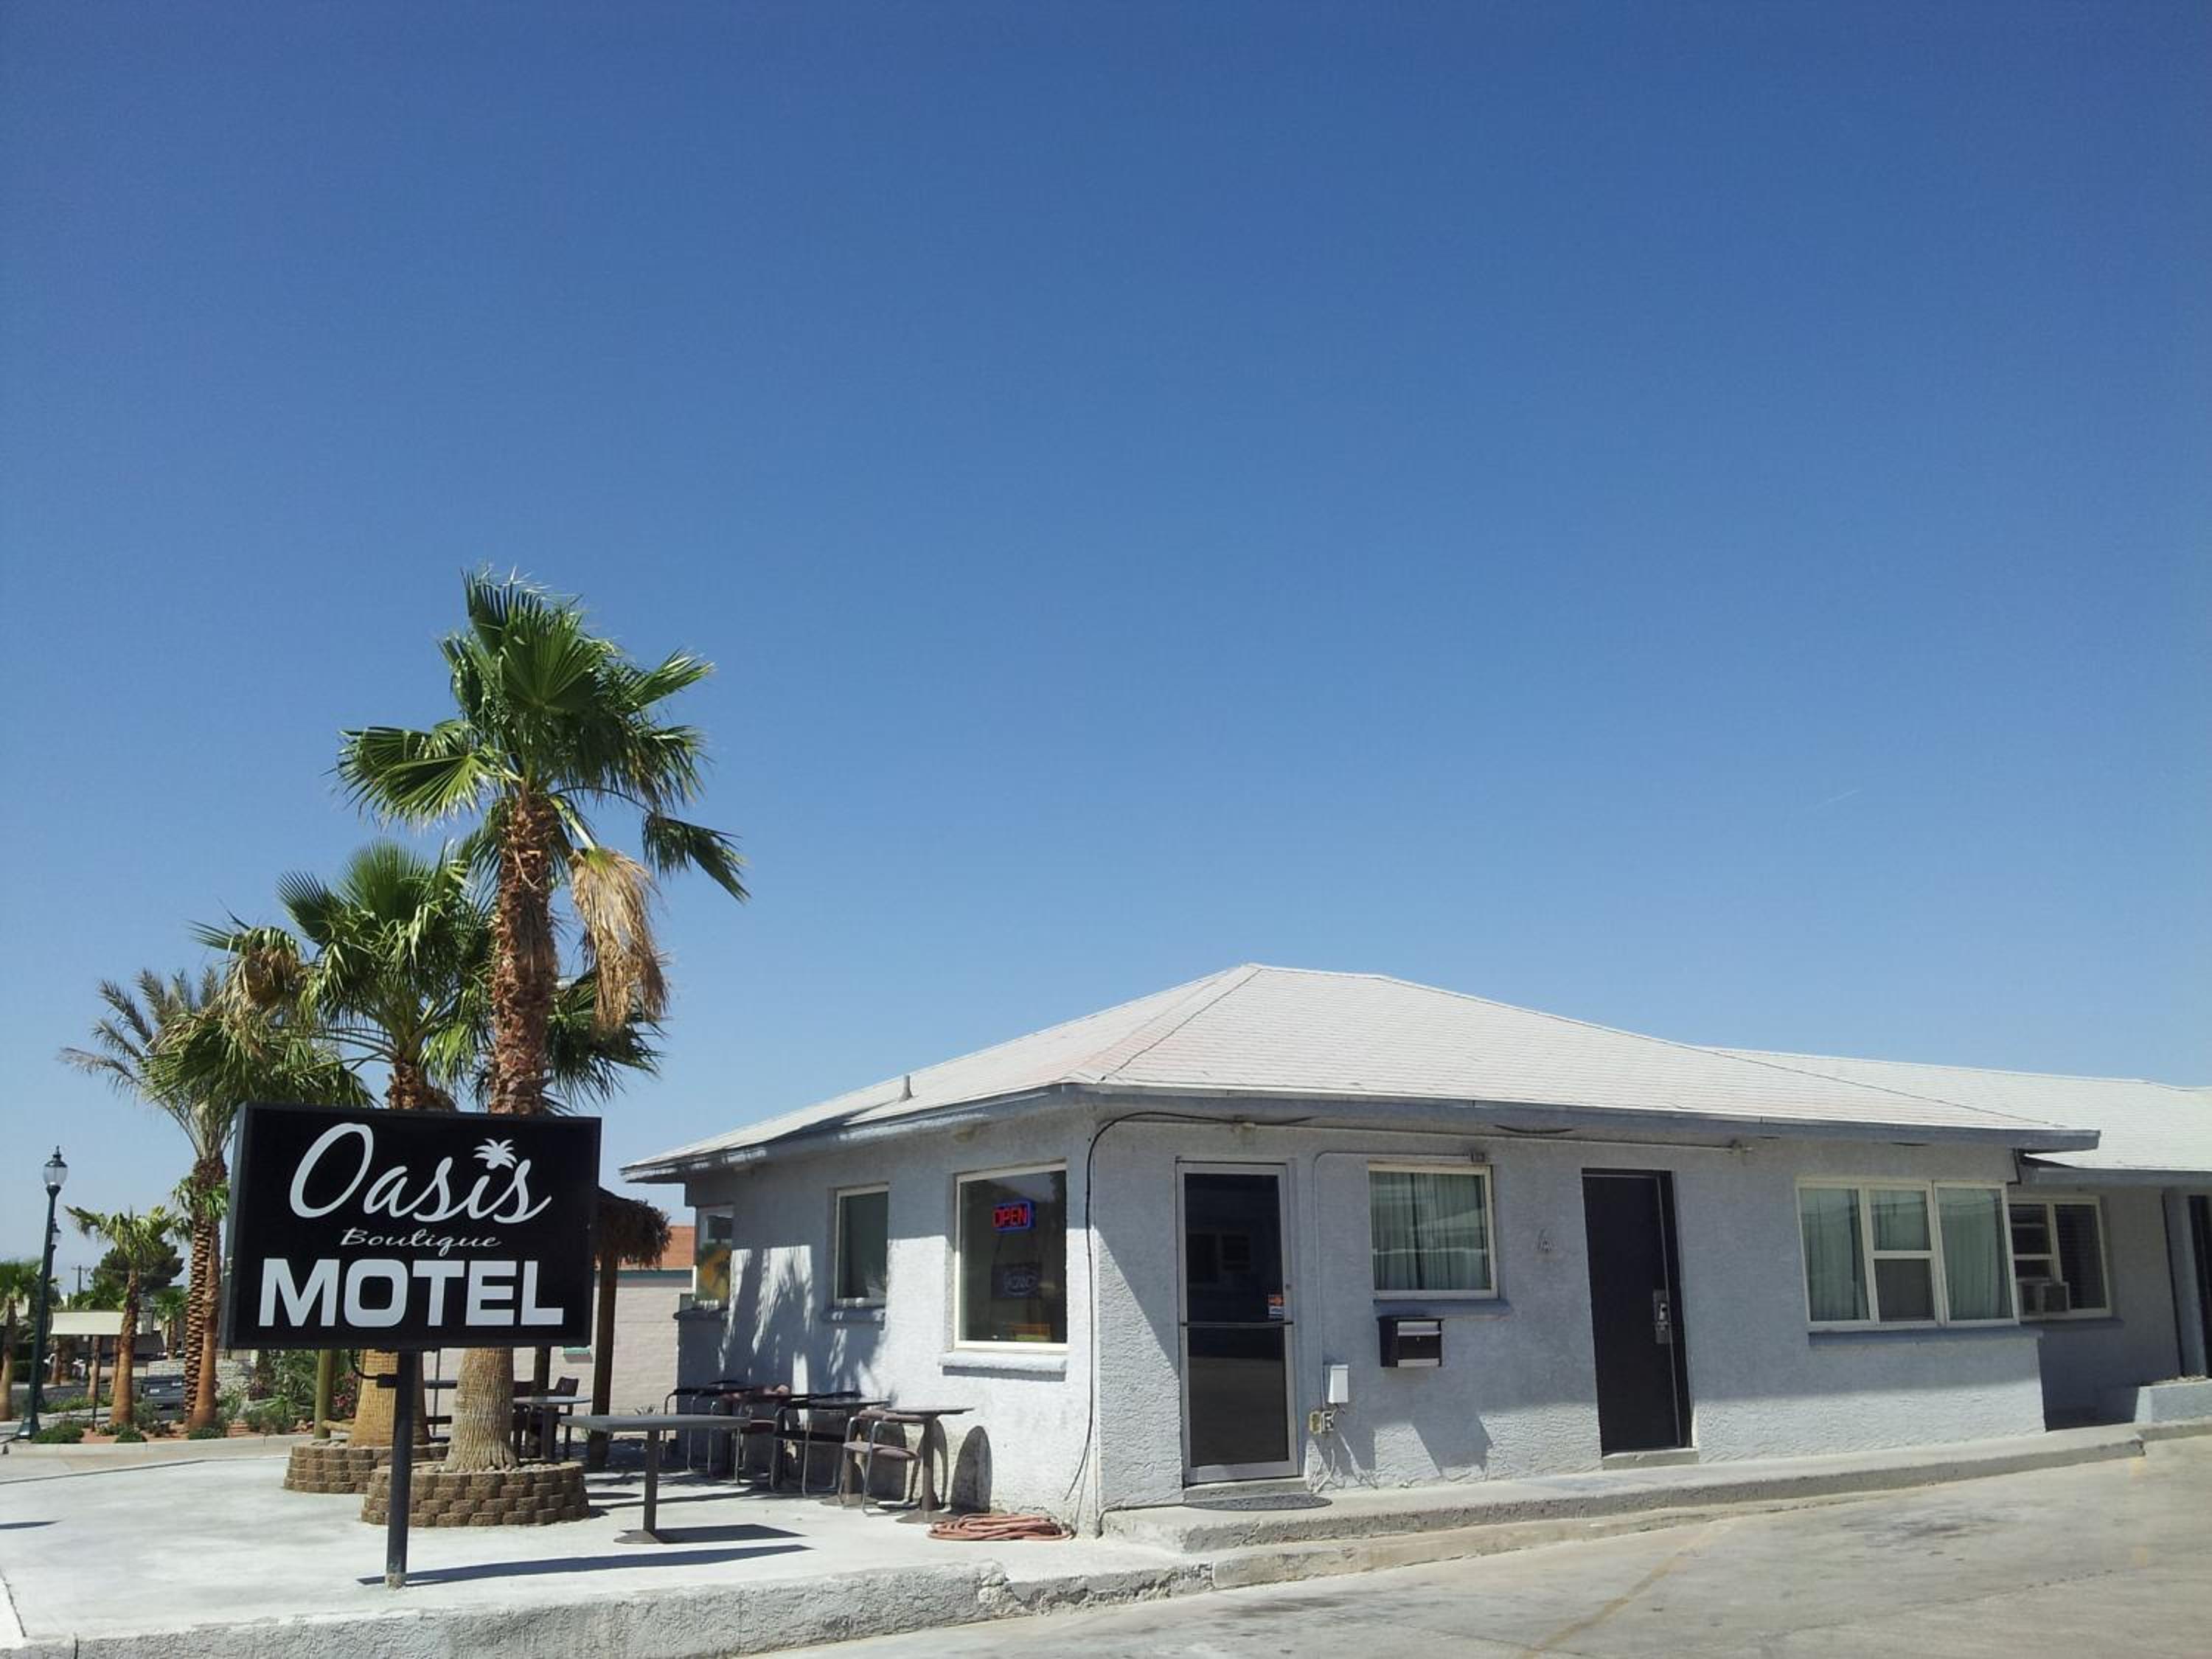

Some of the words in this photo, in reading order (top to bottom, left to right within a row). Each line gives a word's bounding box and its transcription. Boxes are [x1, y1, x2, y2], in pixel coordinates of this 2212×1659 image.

[289, 1122, 552, 1224] Oasis
[992, 1207, 1027, 1227] OPEN
[340, 1227, 501, 1257] Boutique
[258, 1258, 565, 1327] MOTEL
